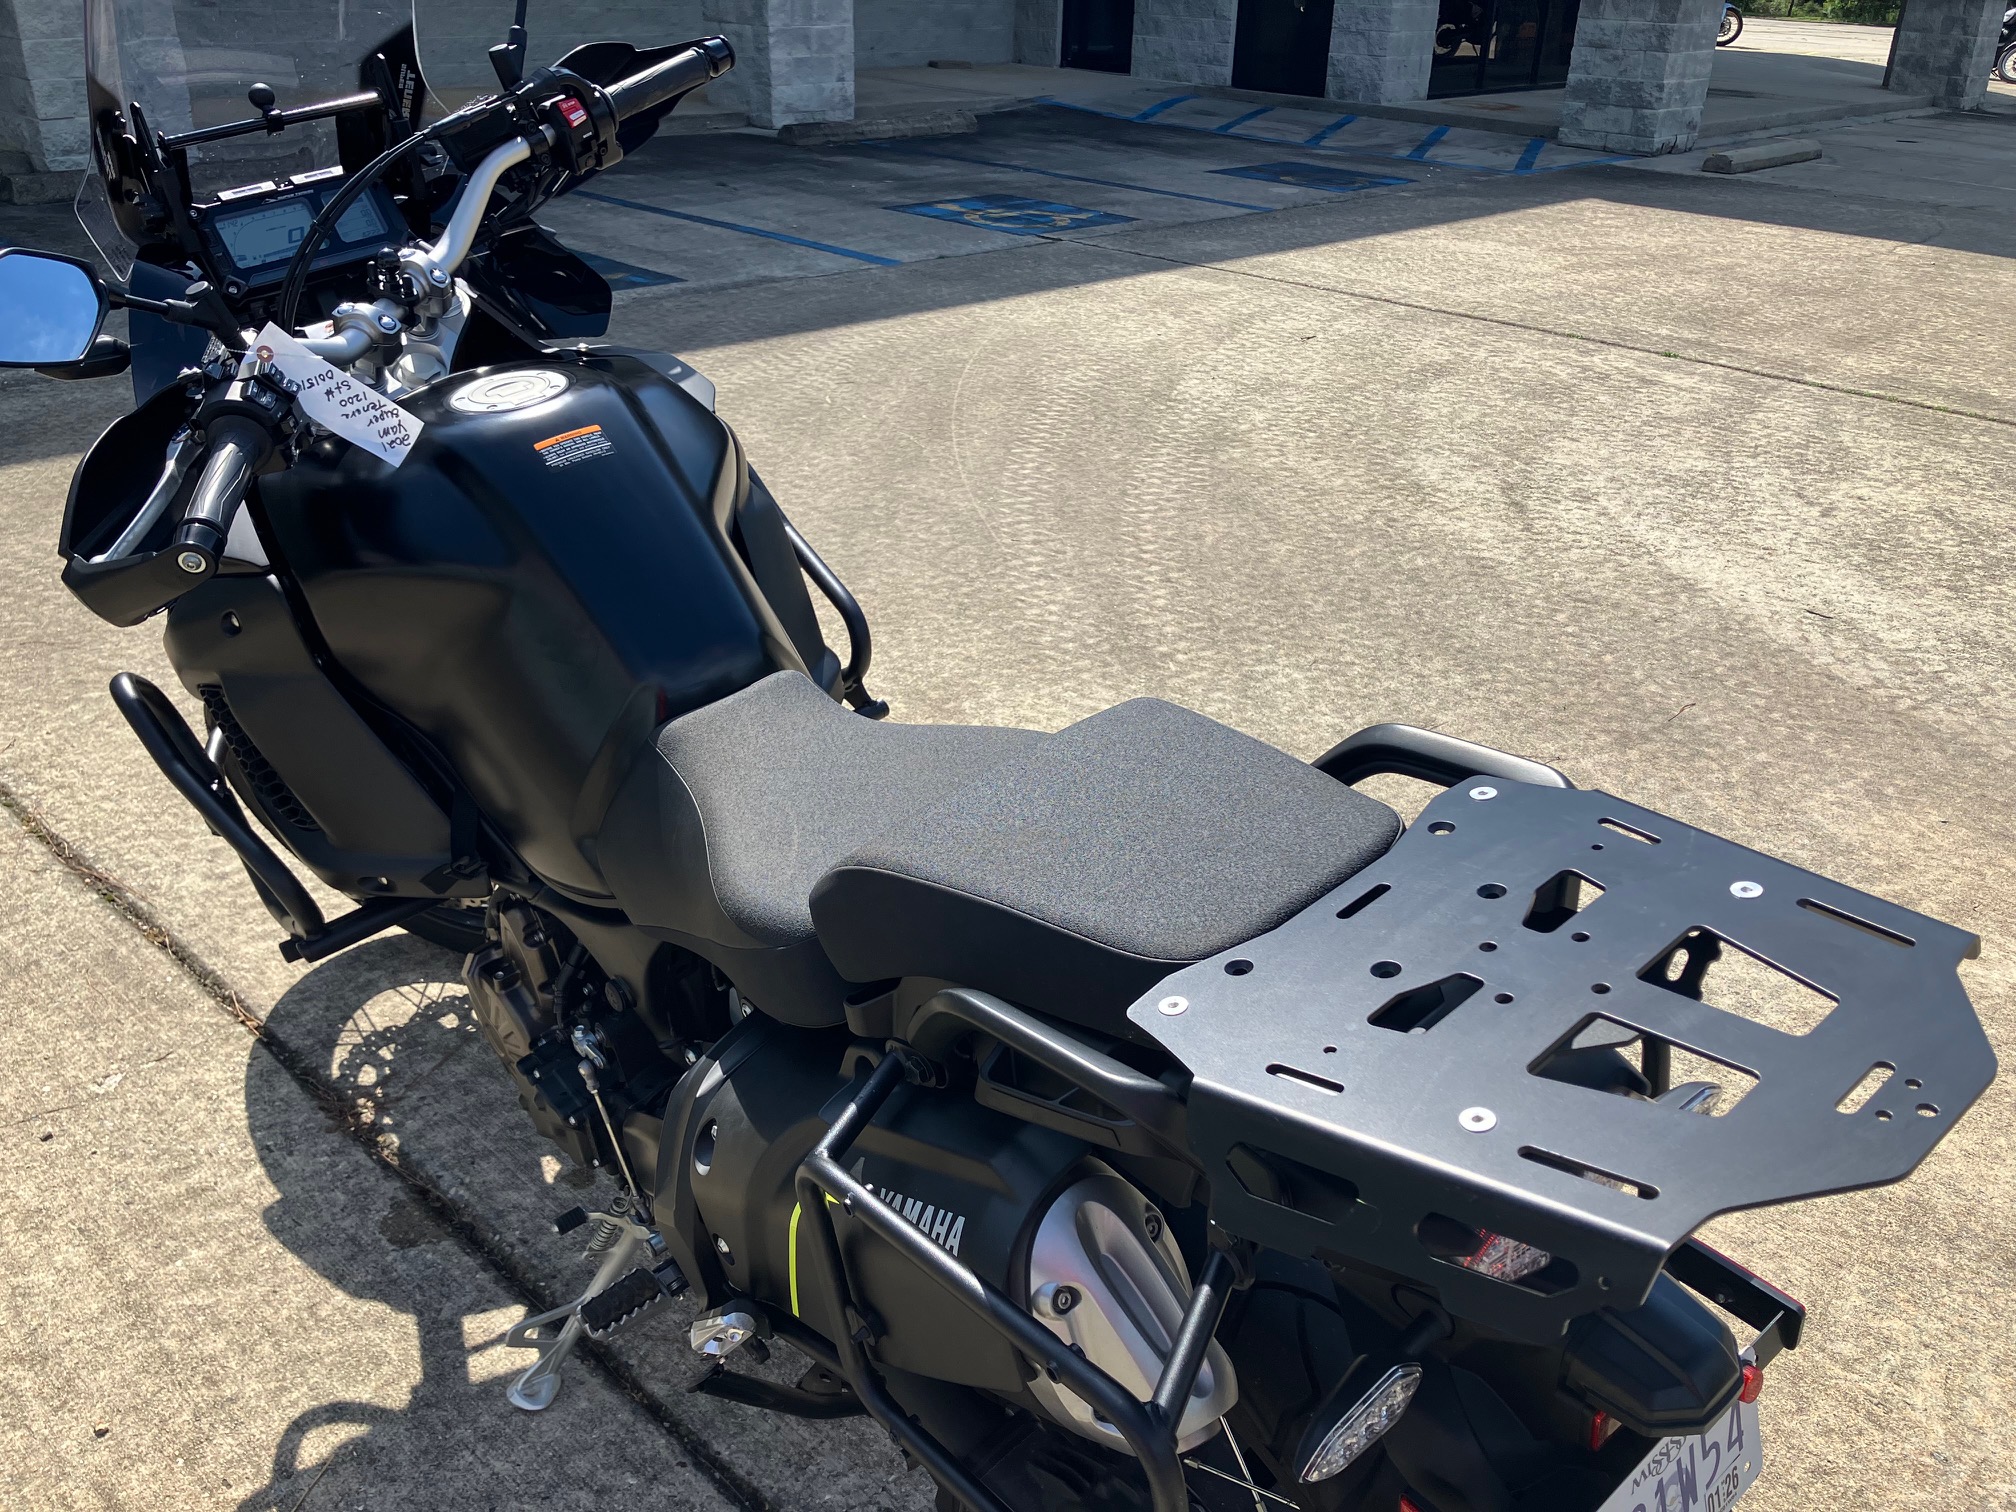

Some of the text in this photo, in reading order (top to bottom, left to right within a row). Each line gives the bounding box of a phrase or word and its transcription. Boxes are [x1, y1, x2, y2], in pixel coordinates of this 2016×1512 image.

[300, 369, 334, 391] 00151
[339, 391, 368, 407] 1200
[382, 433, 411, 453] 2021
[1632, 1400, 1744, 1512] 1W54
